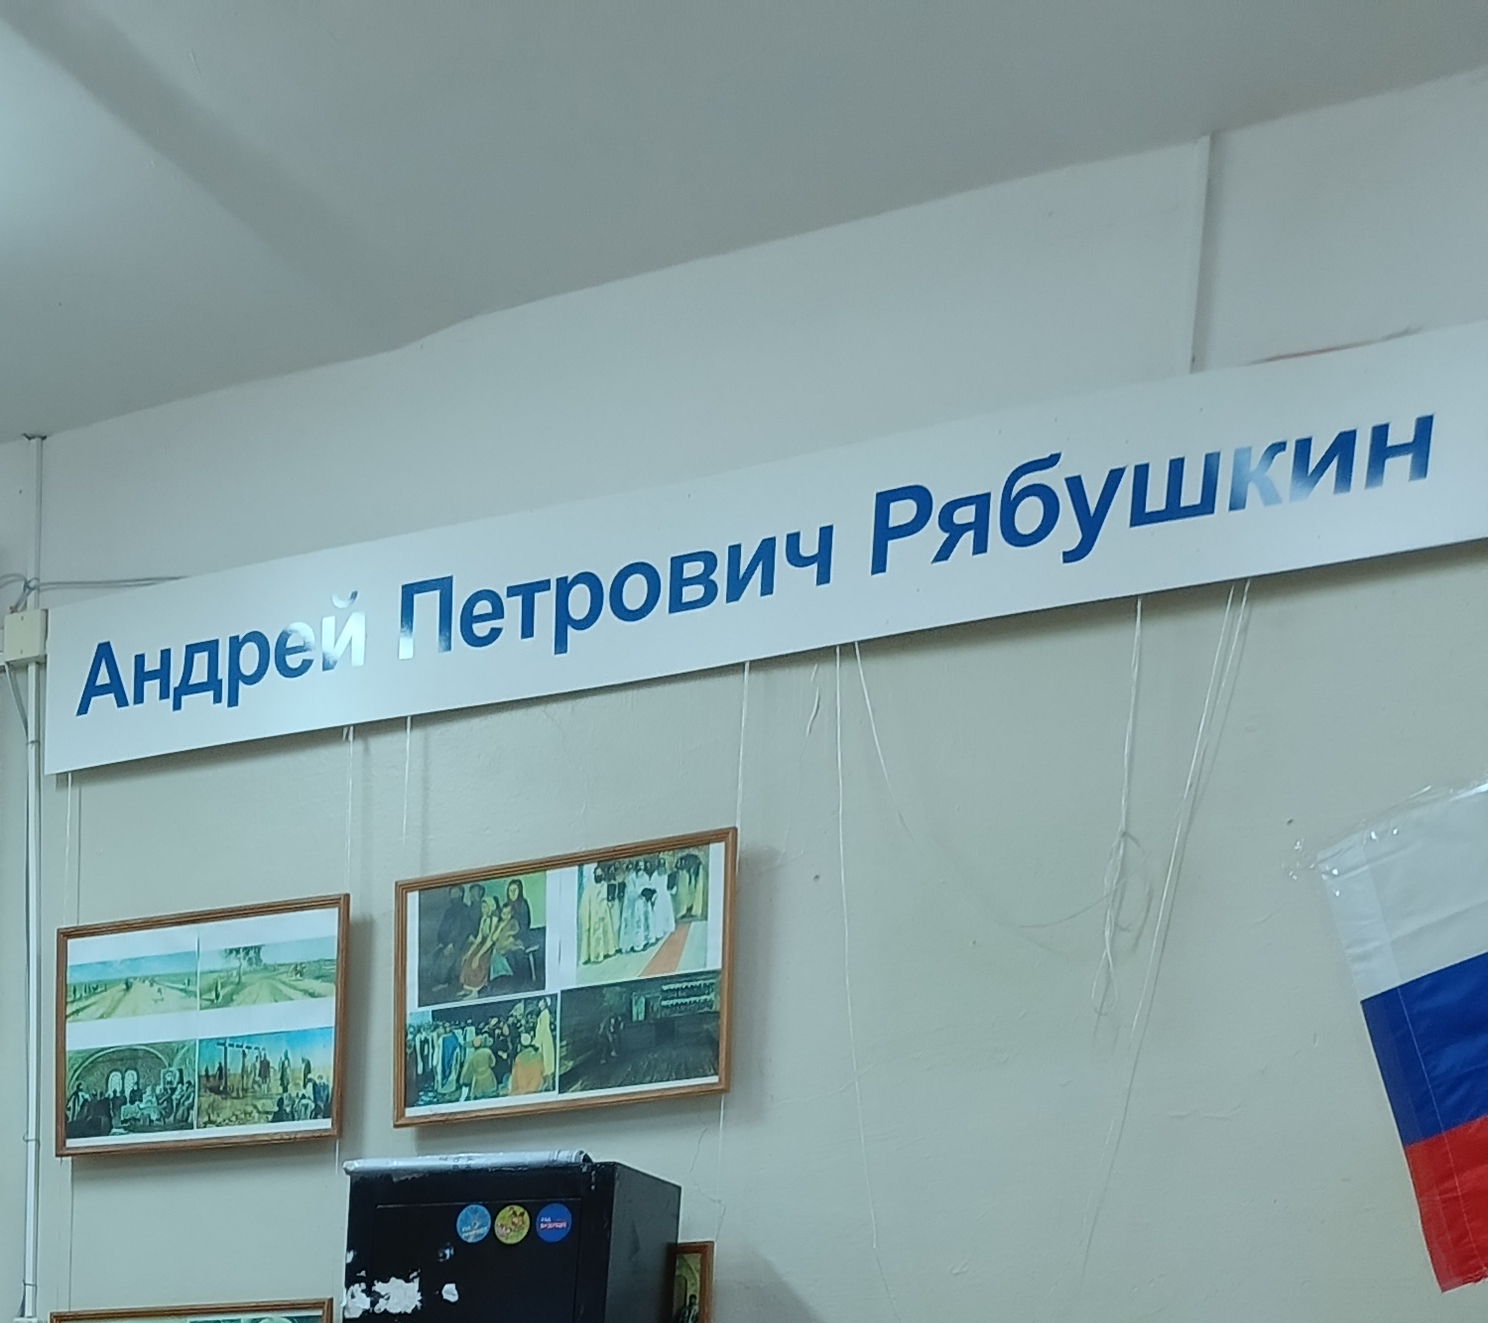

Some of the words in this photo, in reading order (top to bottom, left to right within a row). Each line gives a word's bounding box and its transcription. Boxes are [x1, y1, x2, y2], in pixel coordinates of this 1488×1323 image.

[75, 590, 367, 717] Андрей
[398, 524, 835, 661] Петрович
[870, 413, 1435, 577] Рябушкин
